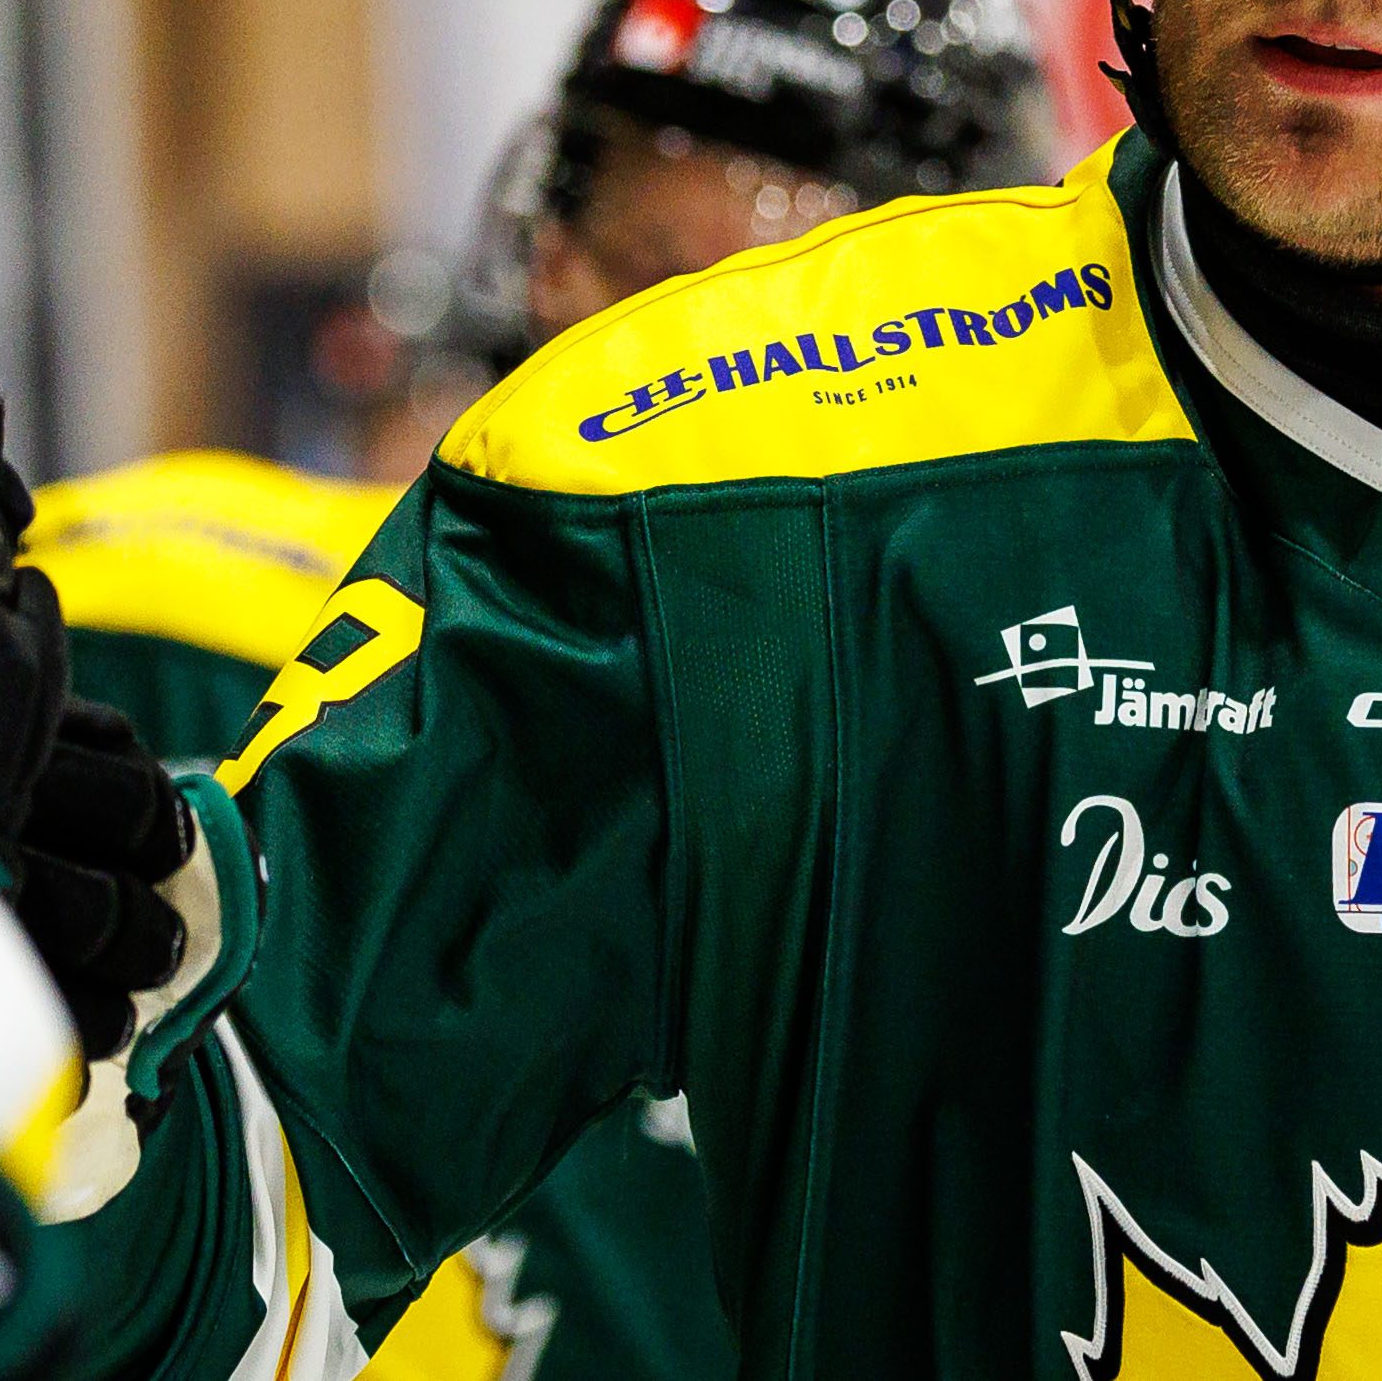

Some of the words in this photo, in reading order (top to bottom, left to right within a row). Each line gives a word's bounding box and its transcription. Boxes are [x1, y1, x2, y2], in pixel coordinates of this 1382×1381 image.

[707, 262, 1113, 393] HALLSTRÖMS
[813, 388, 868, 406] SINCE
[875, 373, 918, 395] 1914
